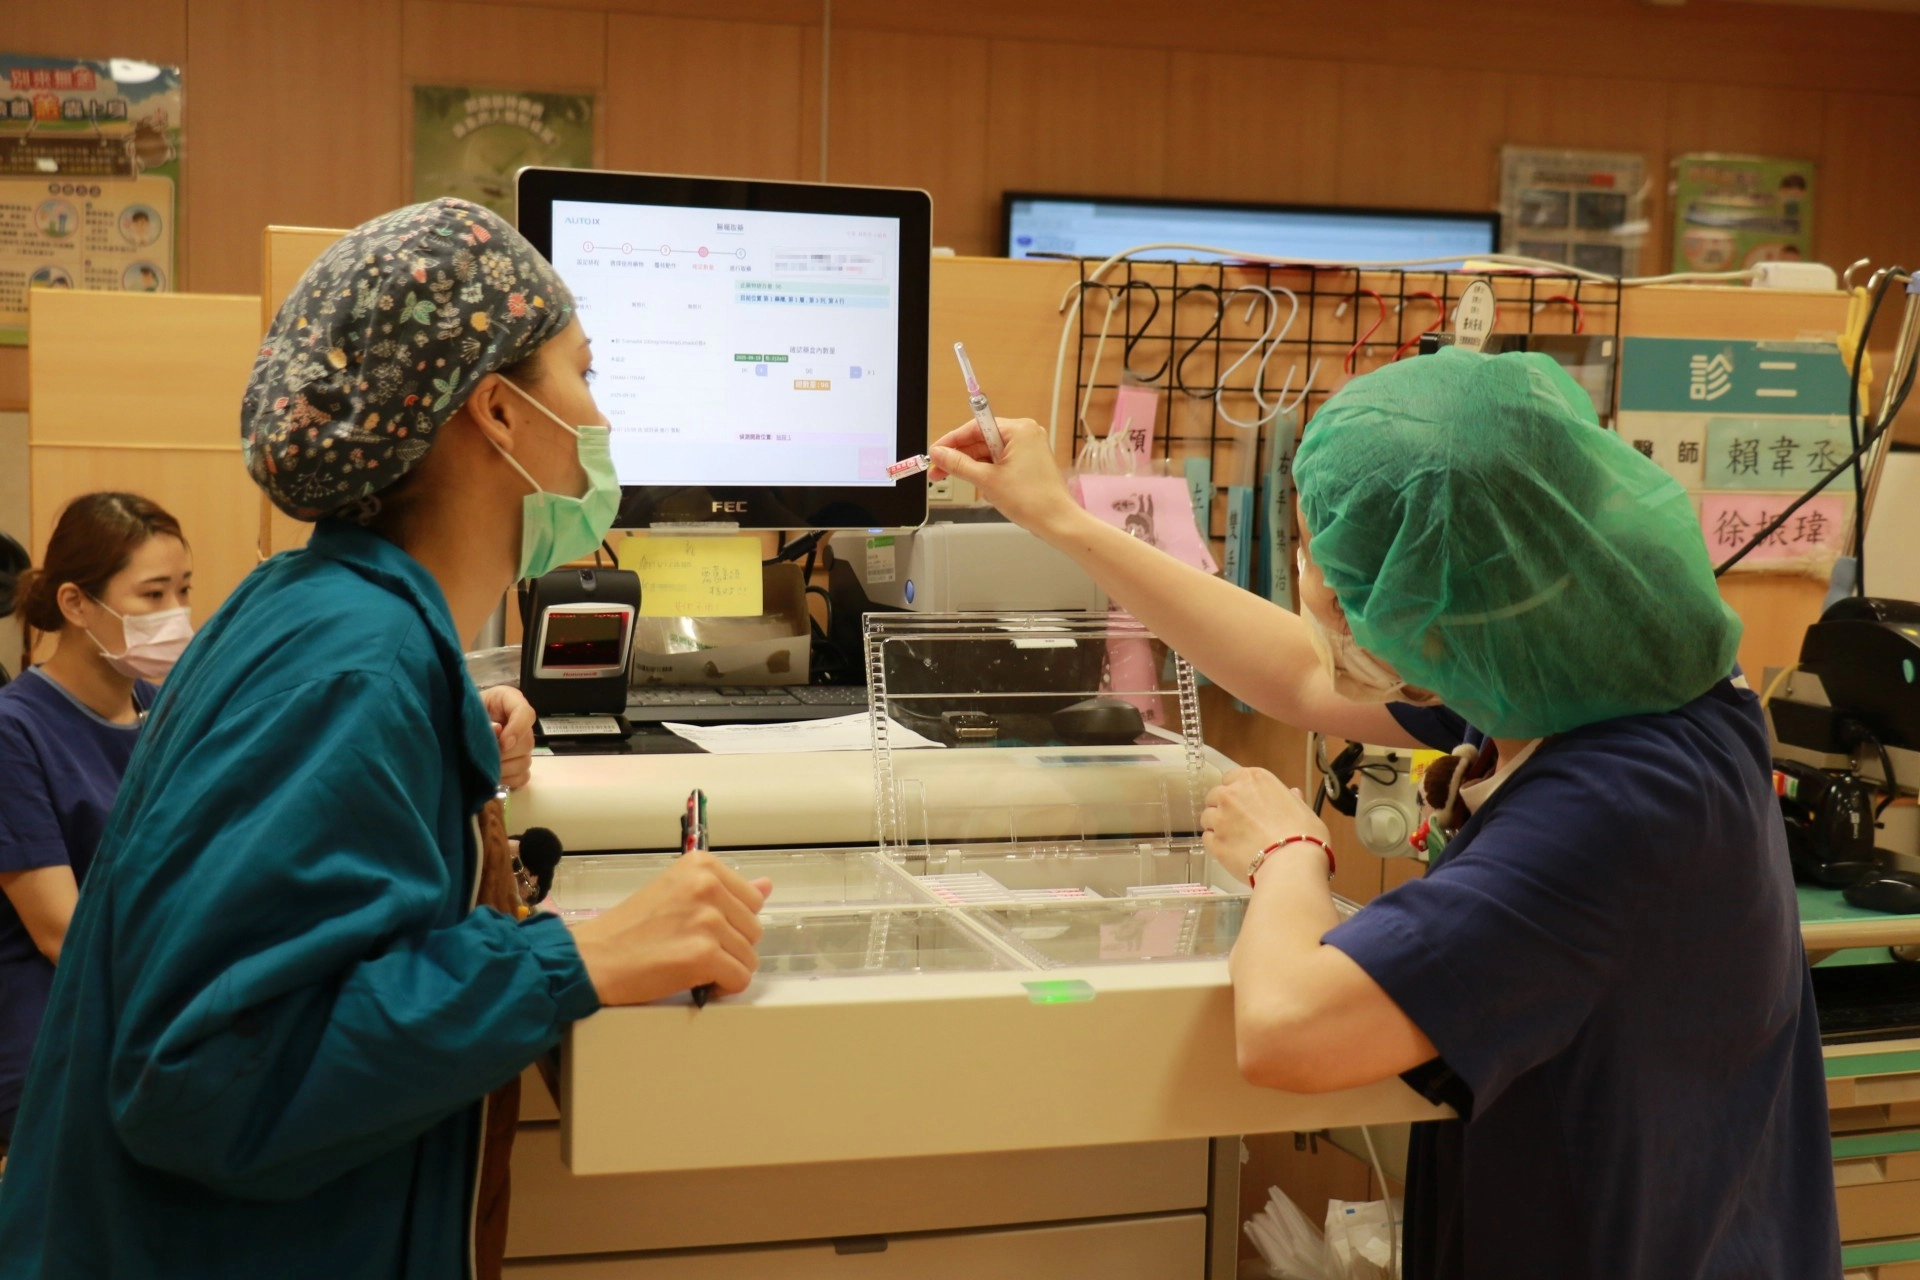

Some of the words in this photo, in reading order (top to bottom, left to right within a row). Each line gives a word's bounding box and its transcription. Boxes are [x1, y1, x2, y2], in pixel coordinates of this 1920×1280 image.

[1690, 354, 1797, 400] 診二
[1726, 435, 1841, 477] 賴韋丞
[712, 501, 748, 513] FEC
